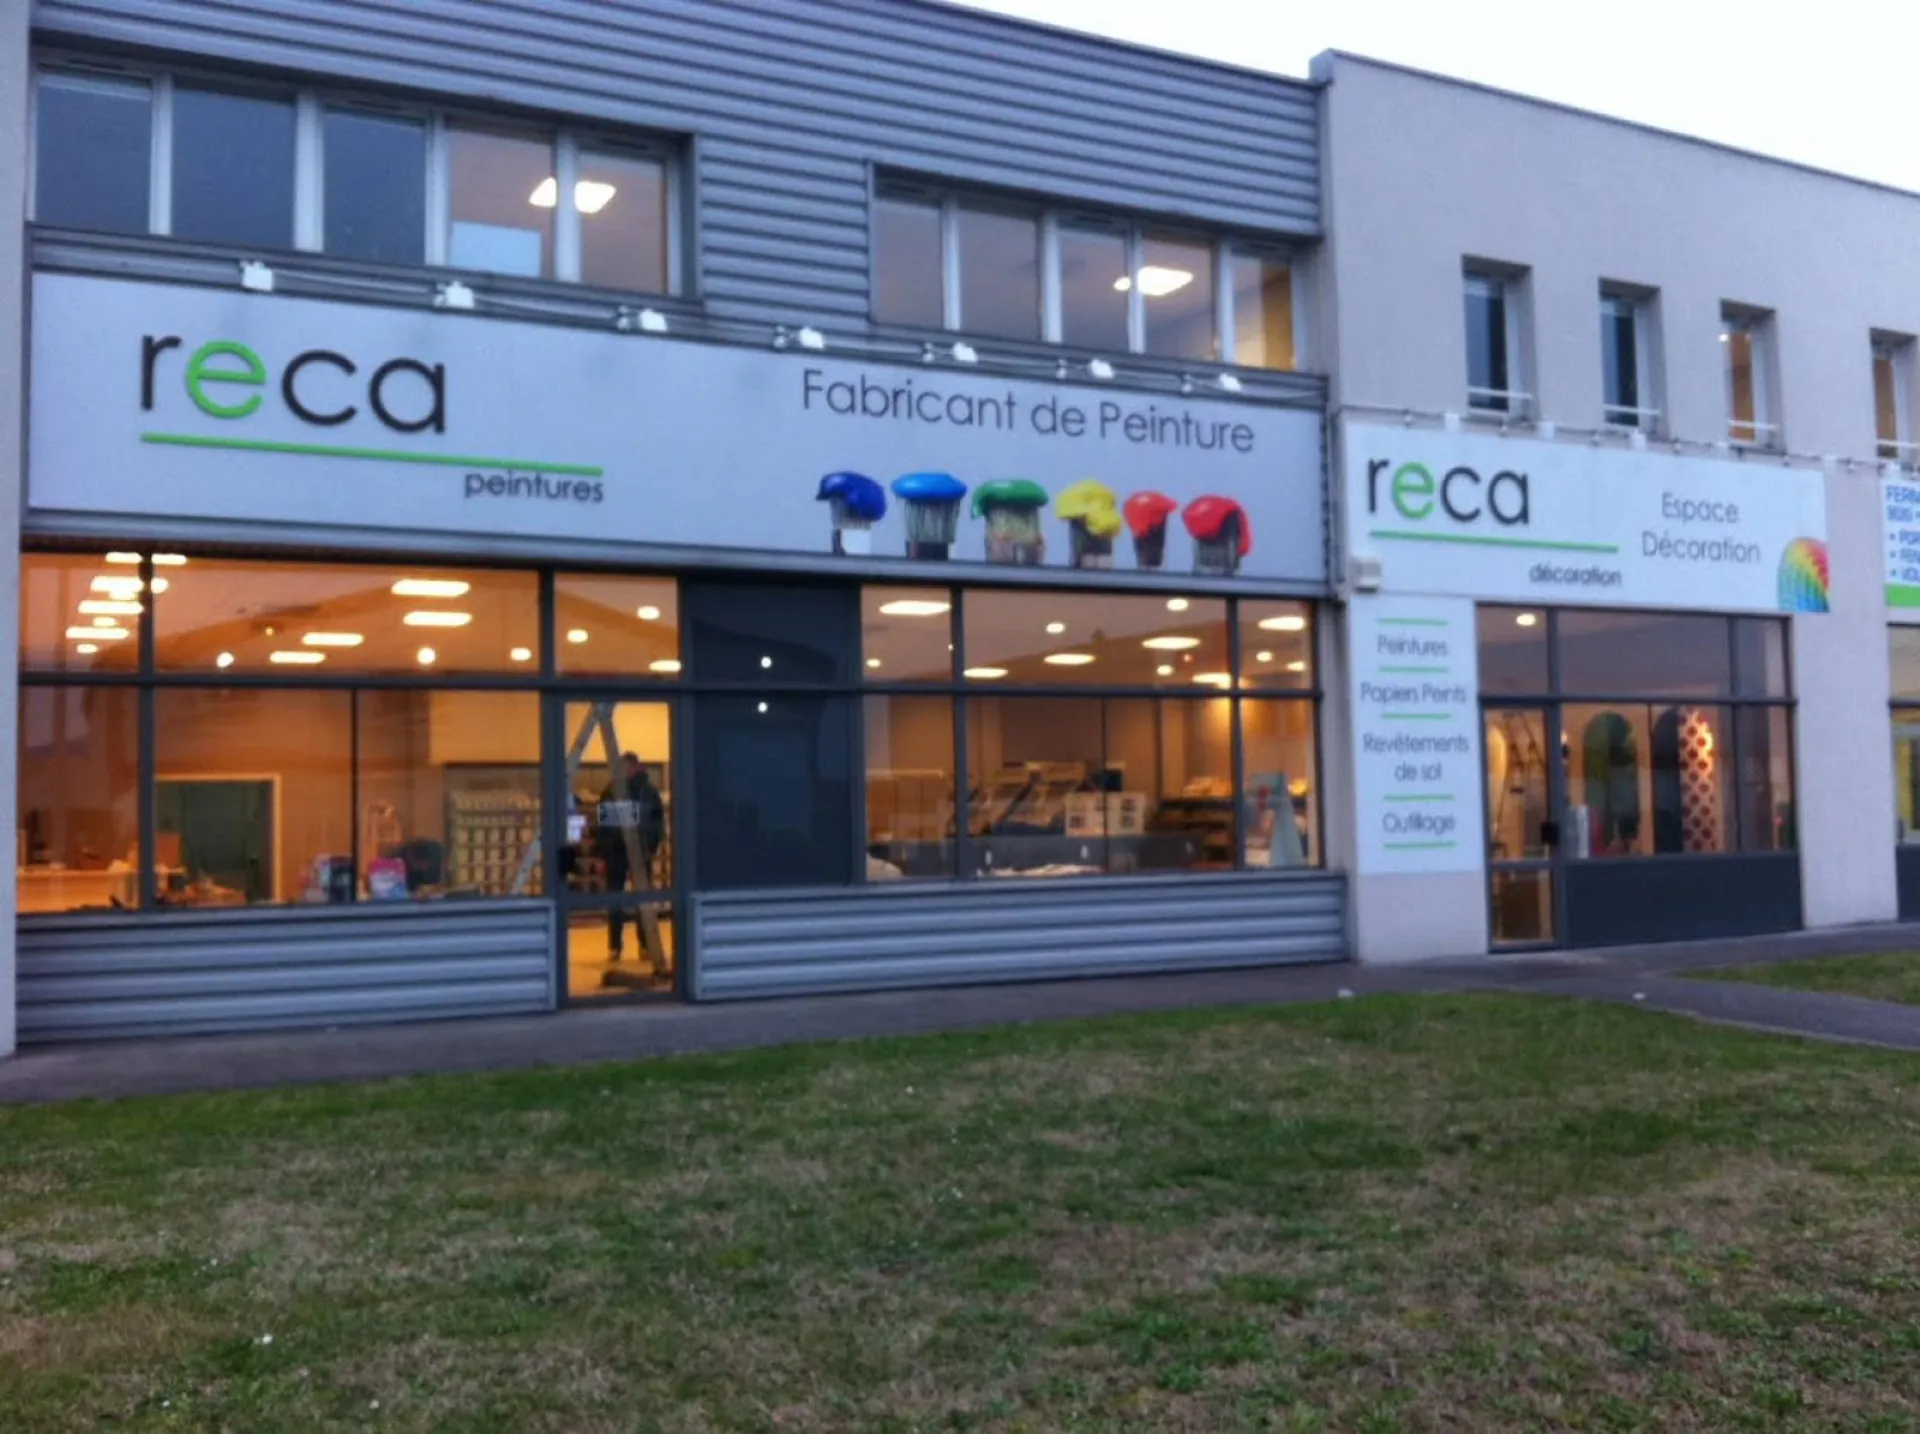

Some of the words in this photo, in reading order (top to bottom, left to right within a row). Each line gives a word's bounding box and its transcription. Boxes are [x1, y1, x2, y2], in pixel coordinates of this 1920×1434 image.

[140, 333, 447, 435] reca
[801, 368, 1017, 431] Fabricant
[1030, 398, 1087, 438] de
[1099, 400, 1255, 453] Peinture
[463, 469, 605, 502] peintures
[1367, 457, 1530, 526] reca
[1661, 491, 1739, 524] Espace
[1641, 531, 1761, 565] Décoration
[1528, 560, 1623, 588] décoration
[1376, 632, 1449, 657] Peintures
[1421, 681, 1467, 704] Peints
[1362, 731, 1470, 754] Revêtements
[1393, 761, 1418, 782] de
[1421, 761, 1443, 782] sol
[1381, 811, 1457, 836] Outillage
